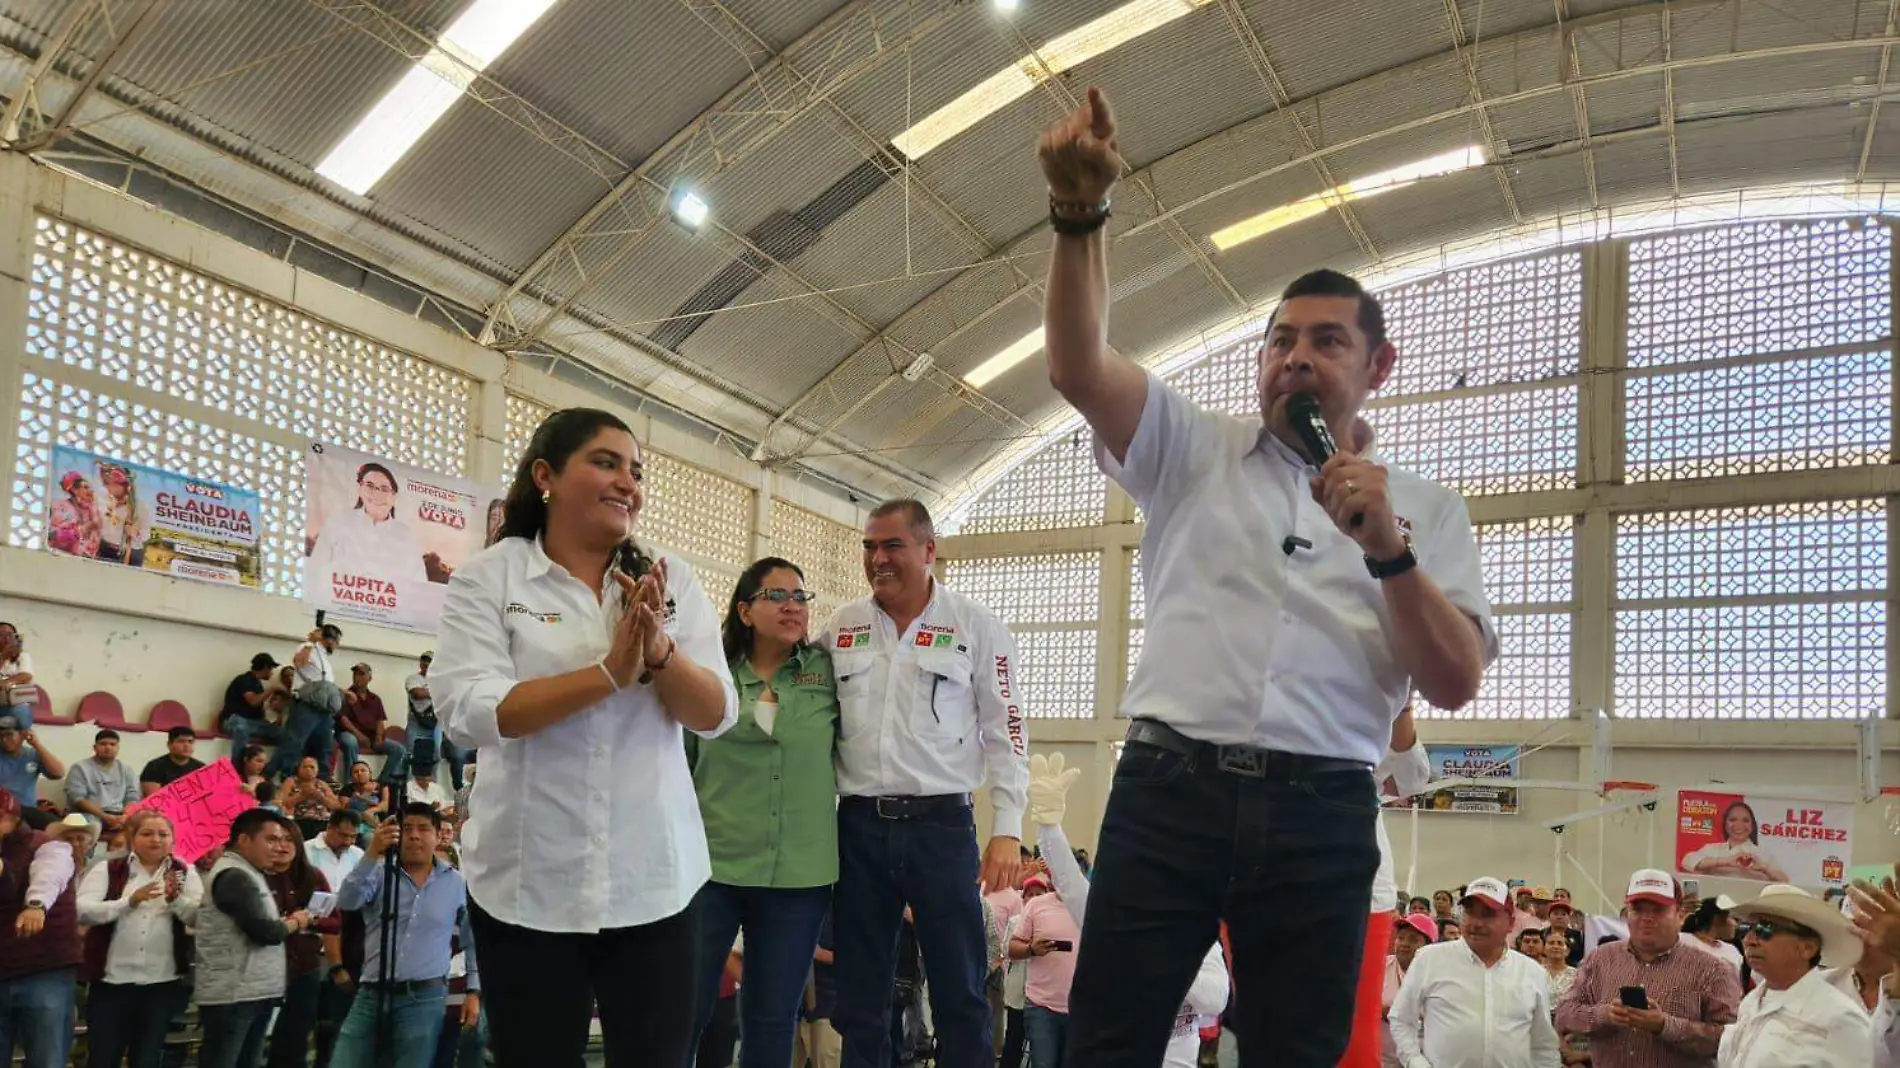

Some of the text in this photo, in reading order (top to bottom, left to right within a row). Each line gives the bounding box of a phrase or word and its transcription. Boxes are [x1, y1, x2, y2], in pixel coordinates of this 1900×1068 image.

[186, 483, 224, 499] VOTA
[156, 492, 251, 525] CLAUDIA
[419, 506, 466, 529] VOTA
[156, 506, 252, 535] SHEINBAUM
[332, 572, 397, 595] LUPITA
[332, 586, 397, 608] VARGAS
[995, 655, 1011, 699] NETO
[1785, 809, 1824, 826] LIZ
[1760, 822, 1848, 842] SÁNCHEZ
